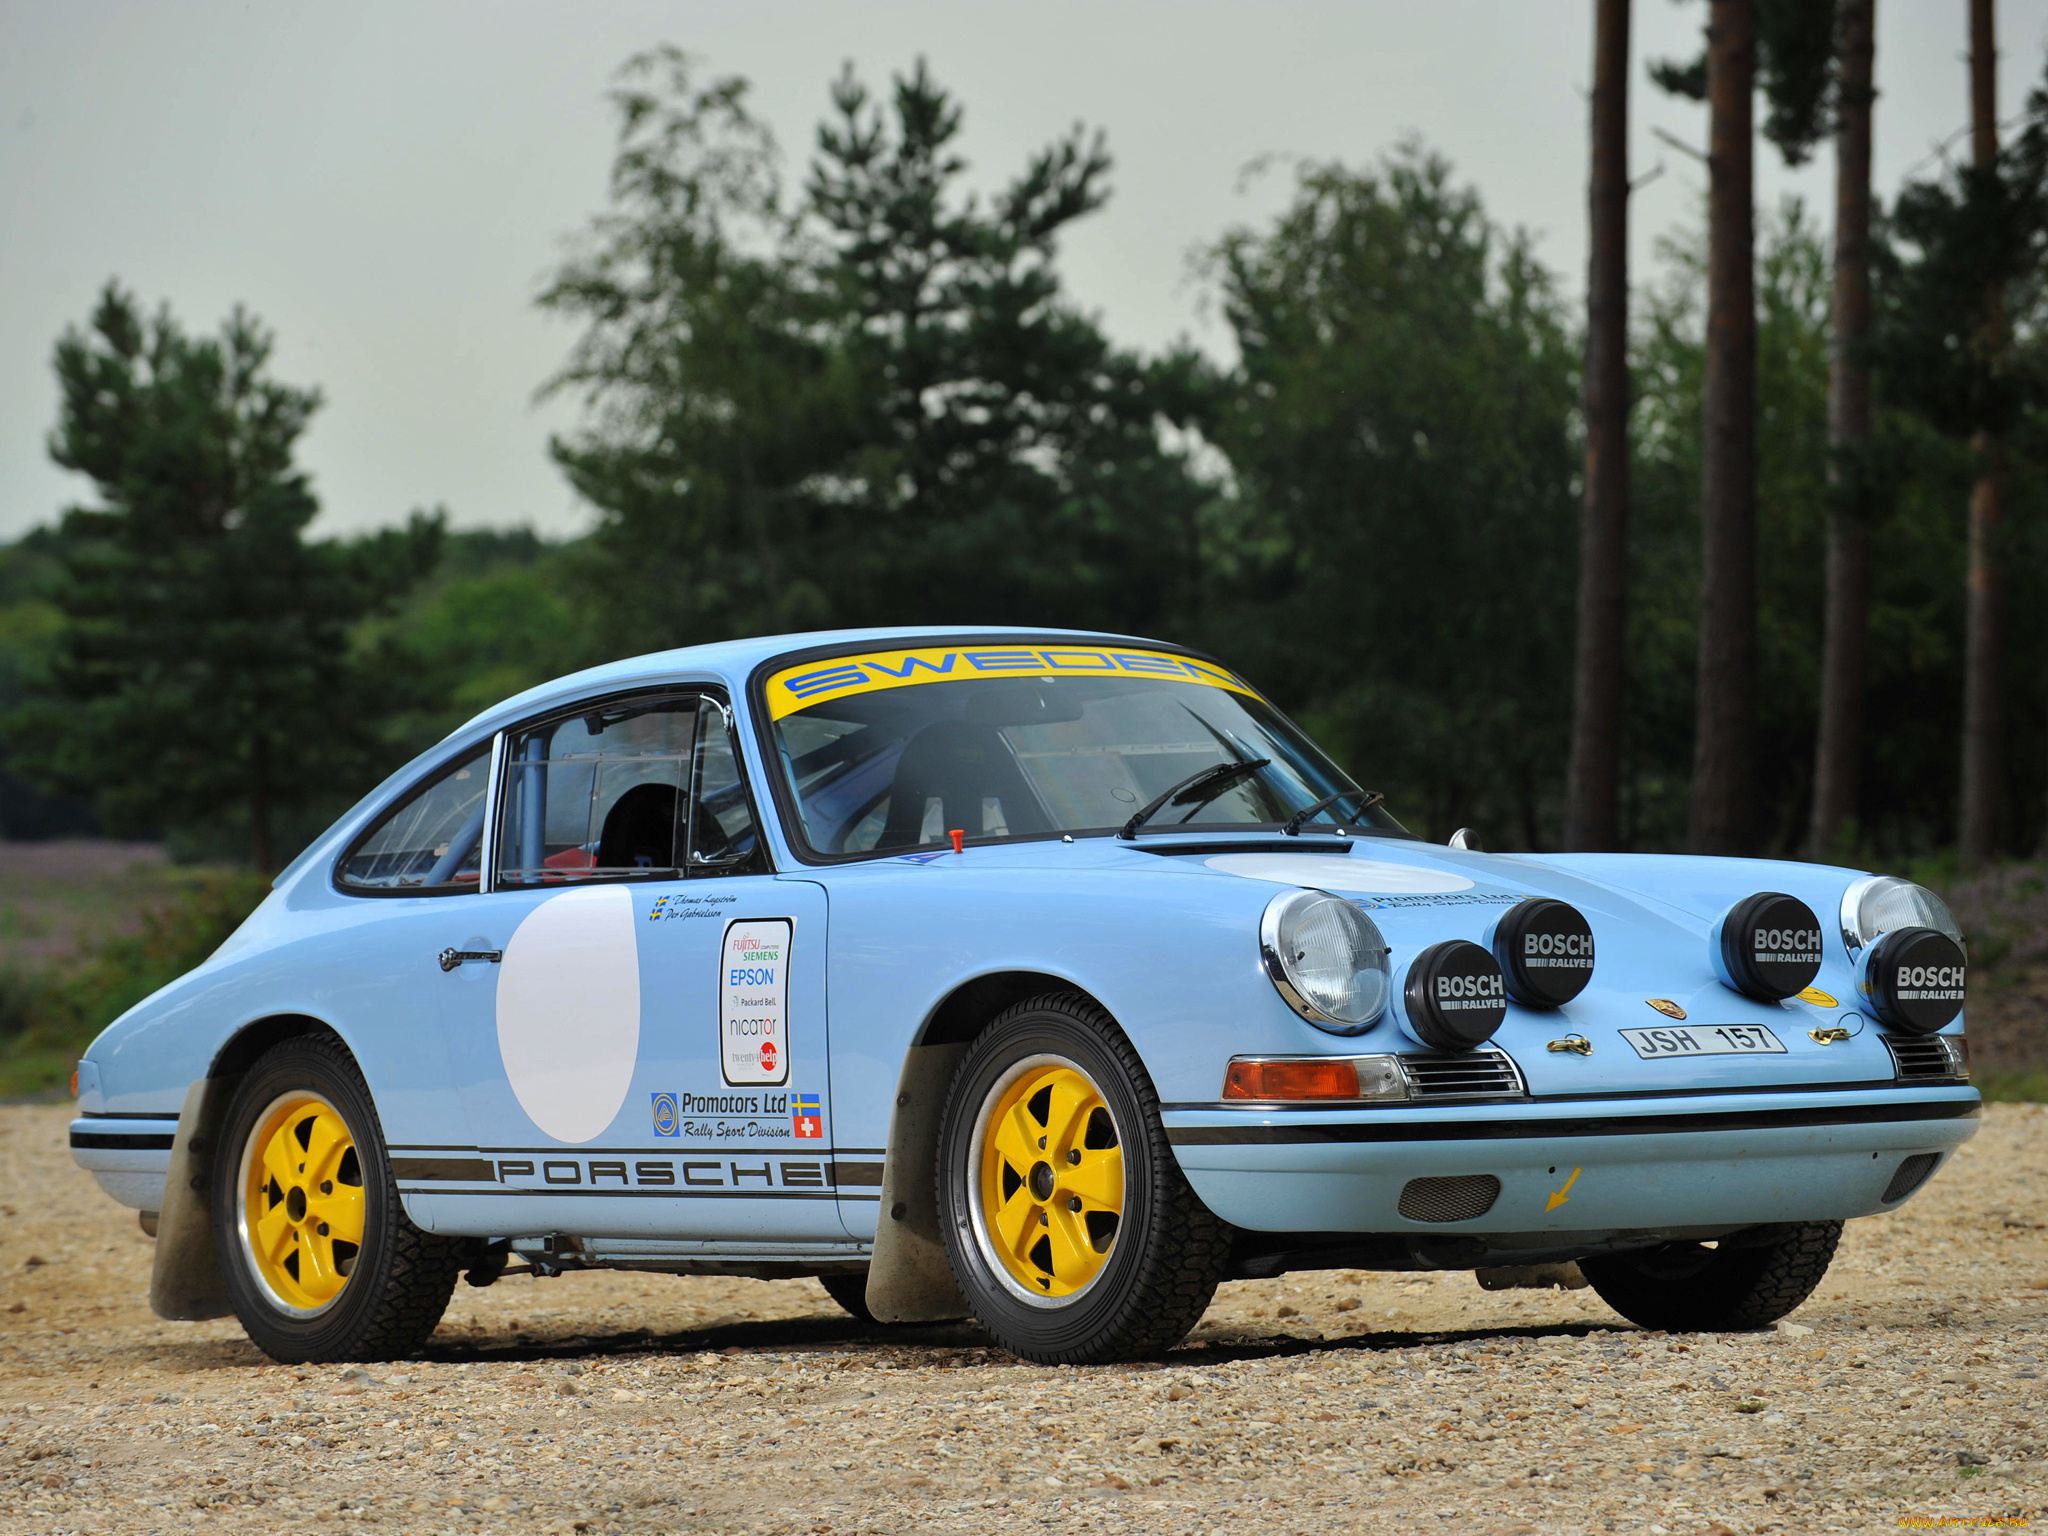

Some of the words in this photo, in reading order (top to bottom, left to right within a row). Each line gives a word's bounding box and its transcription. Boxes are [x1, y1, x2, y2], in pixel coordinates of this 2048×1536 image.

[785, 651, 1250, 699] SWEDEN
[673, 894, 701, 905] Thomas
[1371, 893, 1477, 903] Promotors
[664, 908, 679, 921] Per
[680, 908, 721, 920] Gabrielsson
[733, 939, 760, 952] FUJITSU
[1524, 933, 1593, 956] BOSCH
[1754, 929, 1821, 950] BOSCH
[743, 951, 779, 961] SIEMENS
[1549, 958, 1587, 968] RALLYE
[1777, 953, 1814, 962] RALLYE
[730, 968, 774, 986] EPSON
[1897, 966, 1965, 987] BOSCH
[1437, 974, 1504, 997] BOSCH
[741, 998, 764, 1006] Packard
[1919, 990, 1957, 999] RALLYE
[1462, 999, 1499, 1010] RALLYE
[1638, 1029, 1701, 1053] JSH
[1715, 1027, 1771, 1049] 157
[682, 1092, 758, 1113] Promotors
[763, 1093, 787, 1113] Ltd
[684, 1121, 714, 1140] Rally
[716, 1121, 746, 1141] Sport
[747, 1121, 791, 1138] Division
[497, 1160, 824, 1187] PORSCHE
